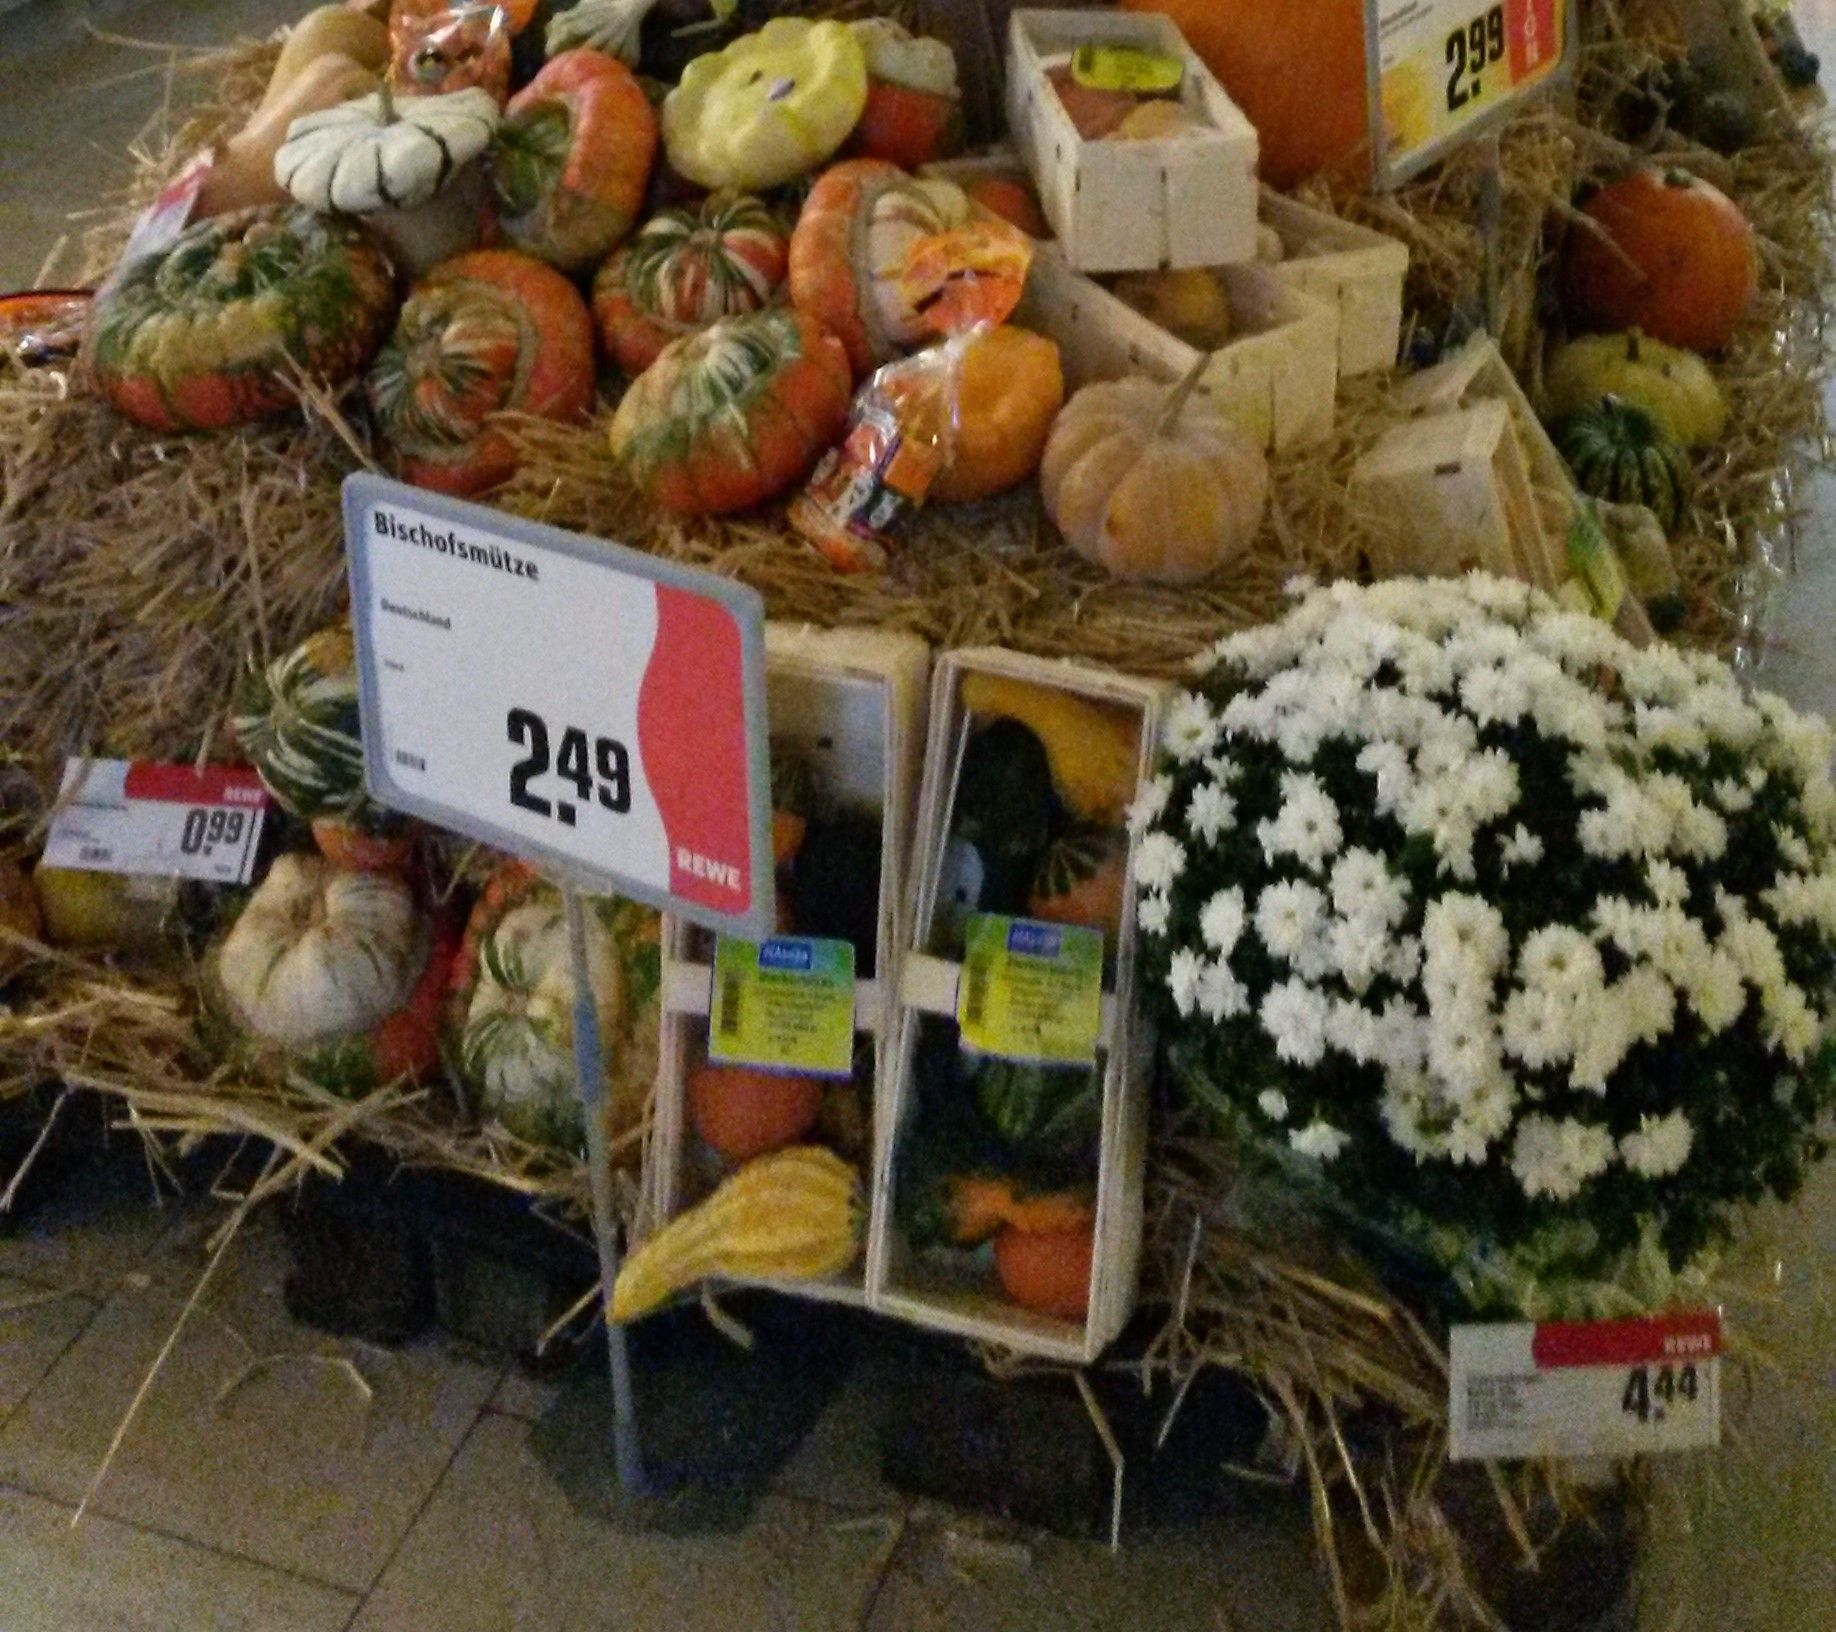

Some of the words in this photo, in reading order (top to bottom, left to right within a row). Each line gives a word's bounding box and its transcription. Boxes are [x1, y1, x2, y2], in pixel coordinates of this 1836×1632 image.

[1444, 2, 1506, 113] 2.99
[373, 510, 540, 581] Bischofsmütze
[506, 705, 633, 828] 2.49
[180, 808, 245, 856] 0.99
[676, 845, 742, 893] REWE
[1621, 1363, 1699, 1423] 4.44
